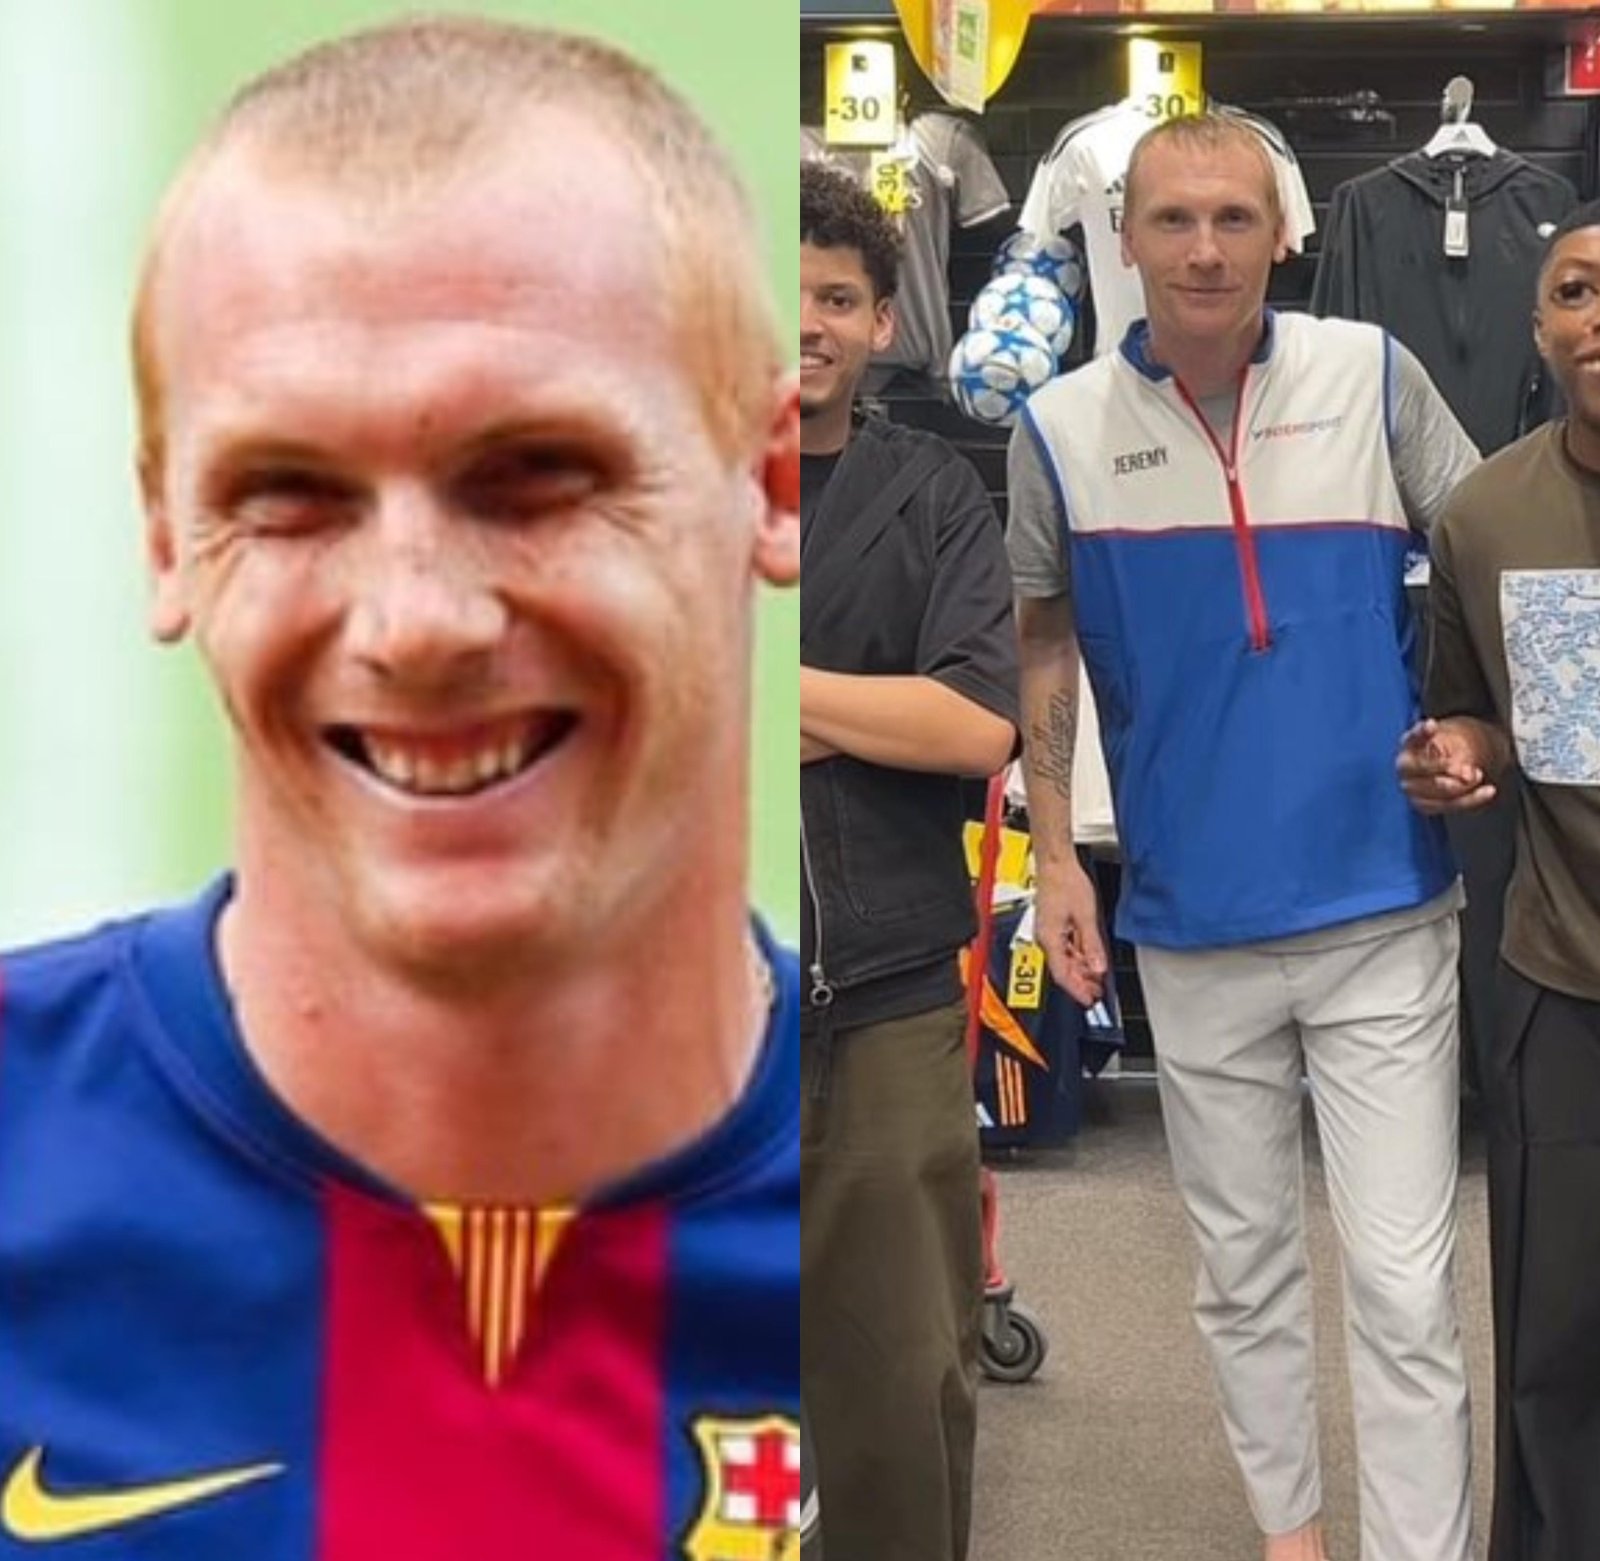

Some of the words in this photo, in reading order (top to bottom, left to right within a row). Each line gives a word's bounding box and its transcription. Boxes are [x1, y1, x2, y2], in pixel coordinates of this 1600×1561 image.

[828, 95, 880, 122] -30
[1131, 94, 1186, 119] -30
[876, 163, 899, 204] -30
[1114, 447, 1169, 475] JEREMY
[1015, 954, 1036, 995] -30
